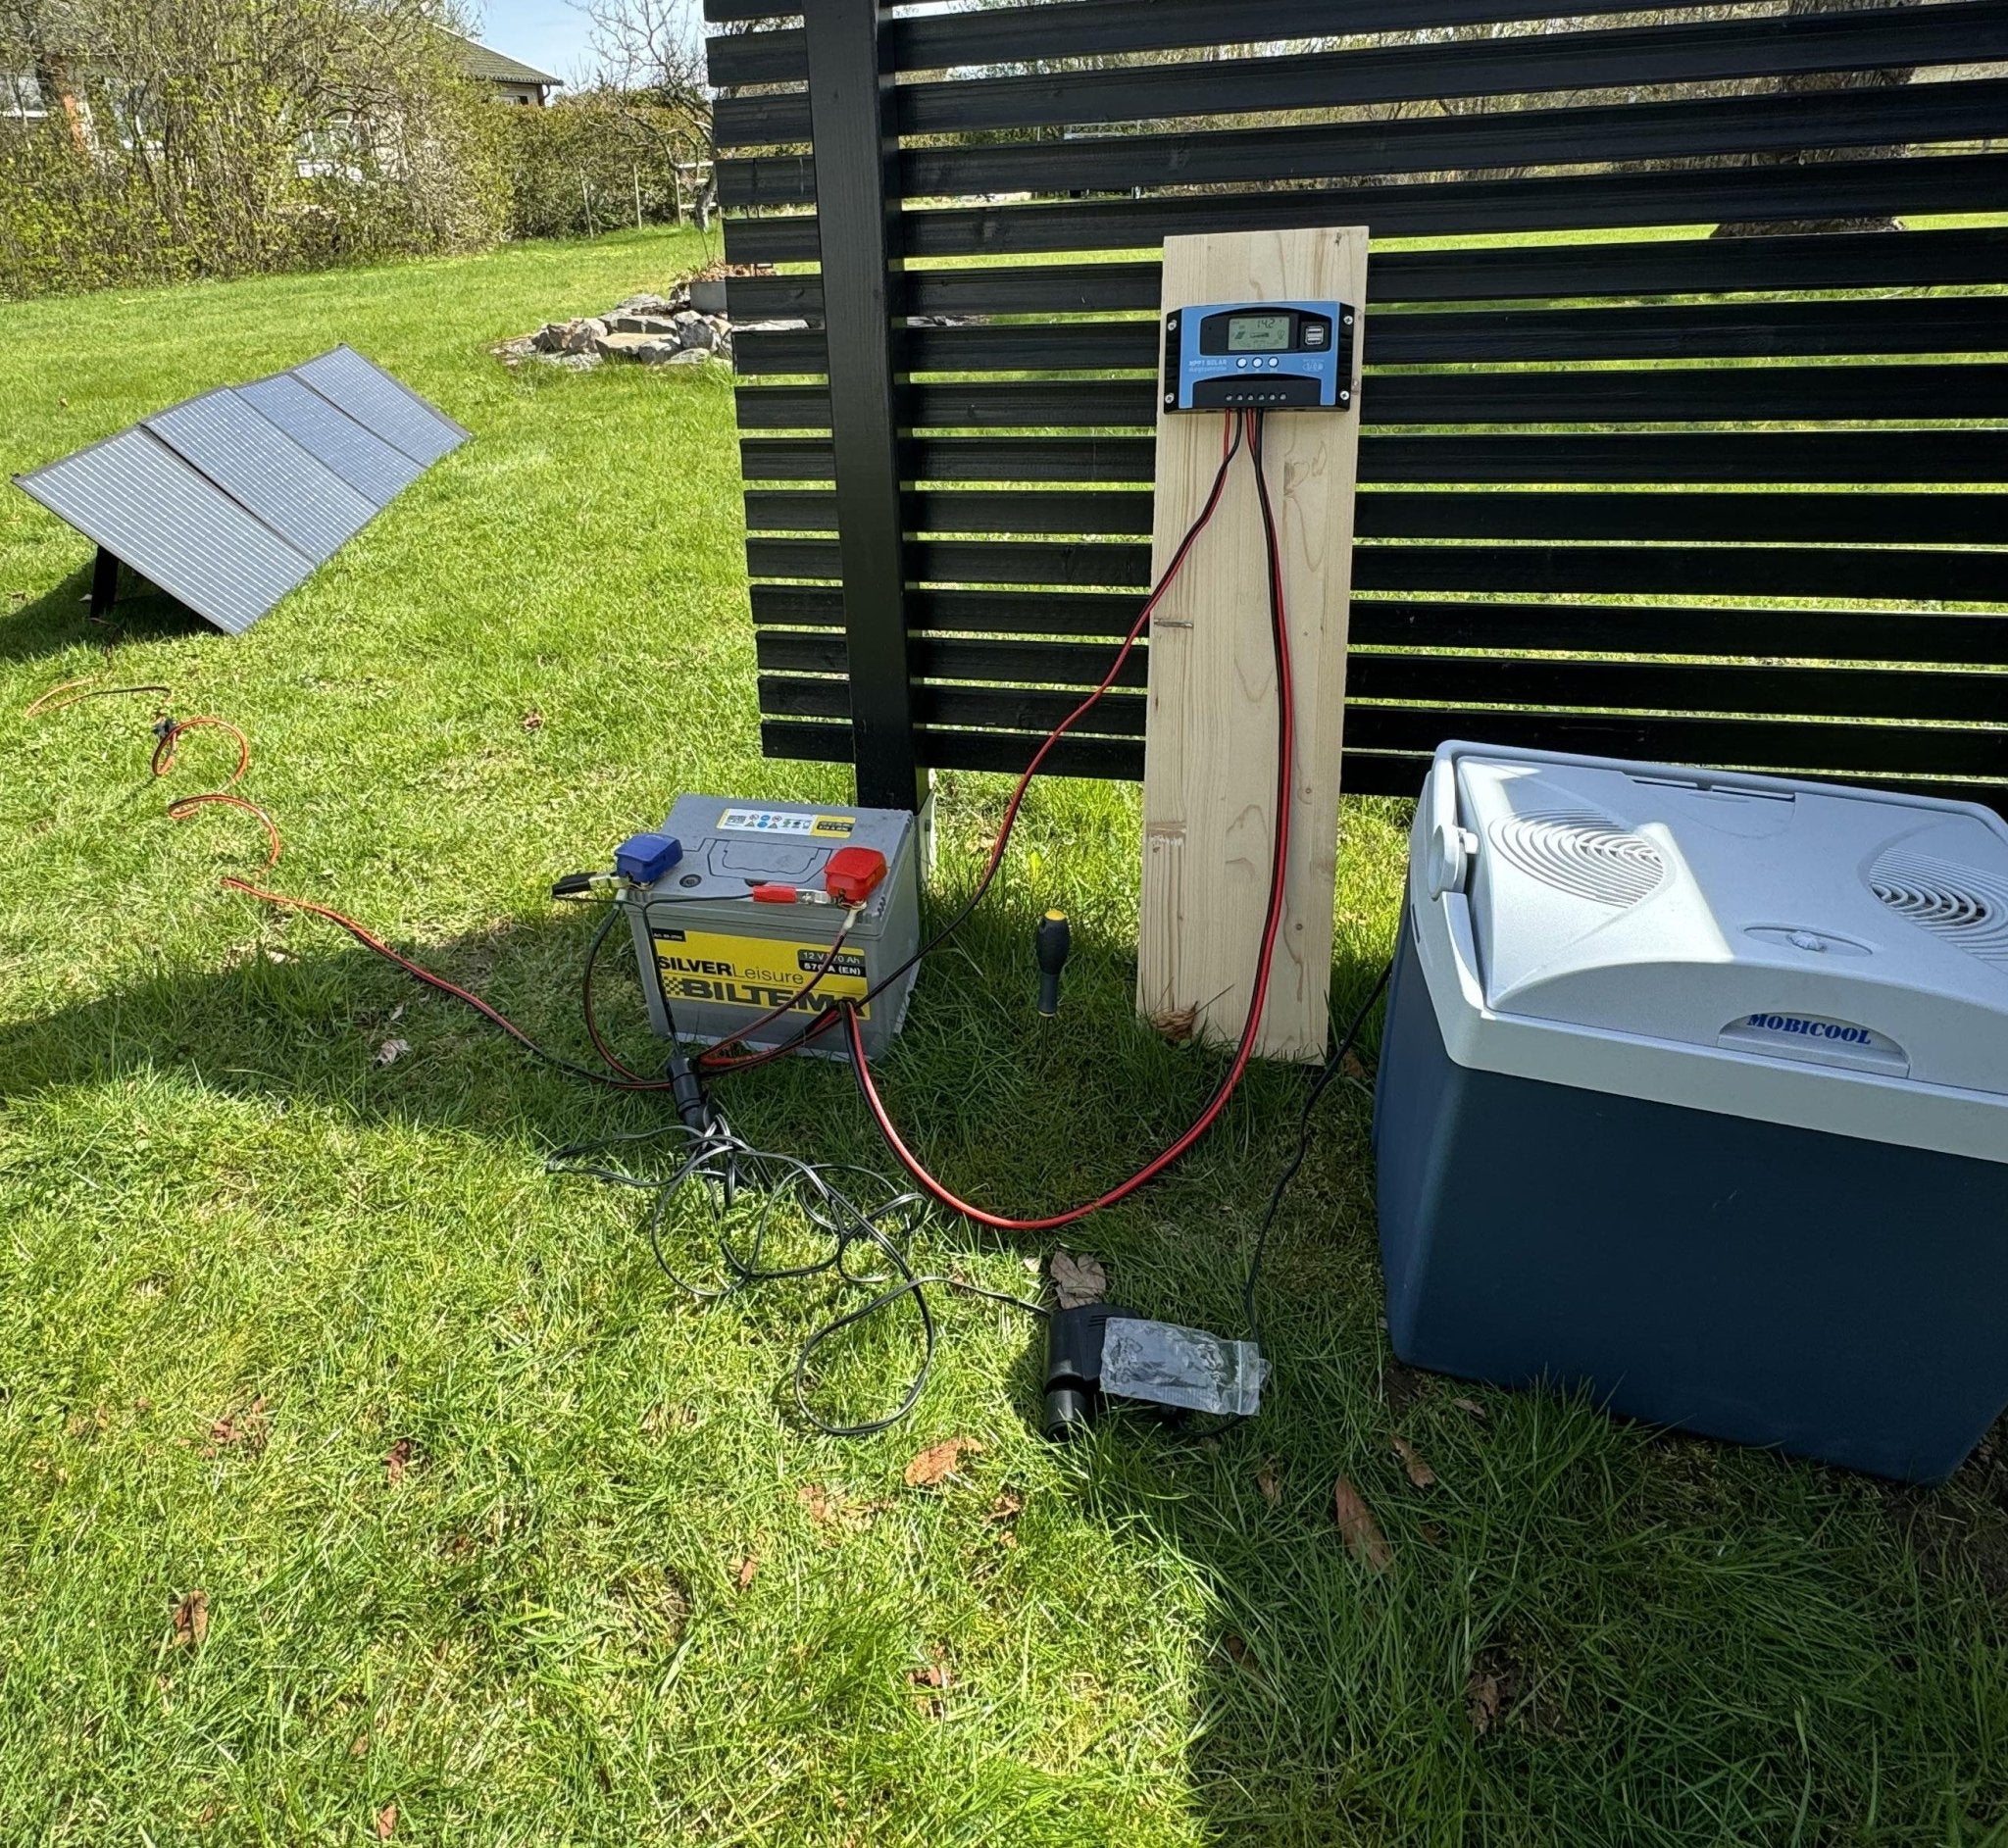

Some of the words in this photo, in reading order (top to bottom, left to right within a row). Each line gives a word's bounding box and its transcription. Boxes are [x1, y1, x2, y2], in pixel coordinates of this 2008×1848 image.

[658, 956, 732, 977] SILVER
[733, 963, 804, 985] Leisure
[838, 965, 861, 975] (EN)
[1746, 1013, 1872, 1046] MOBICOOL
